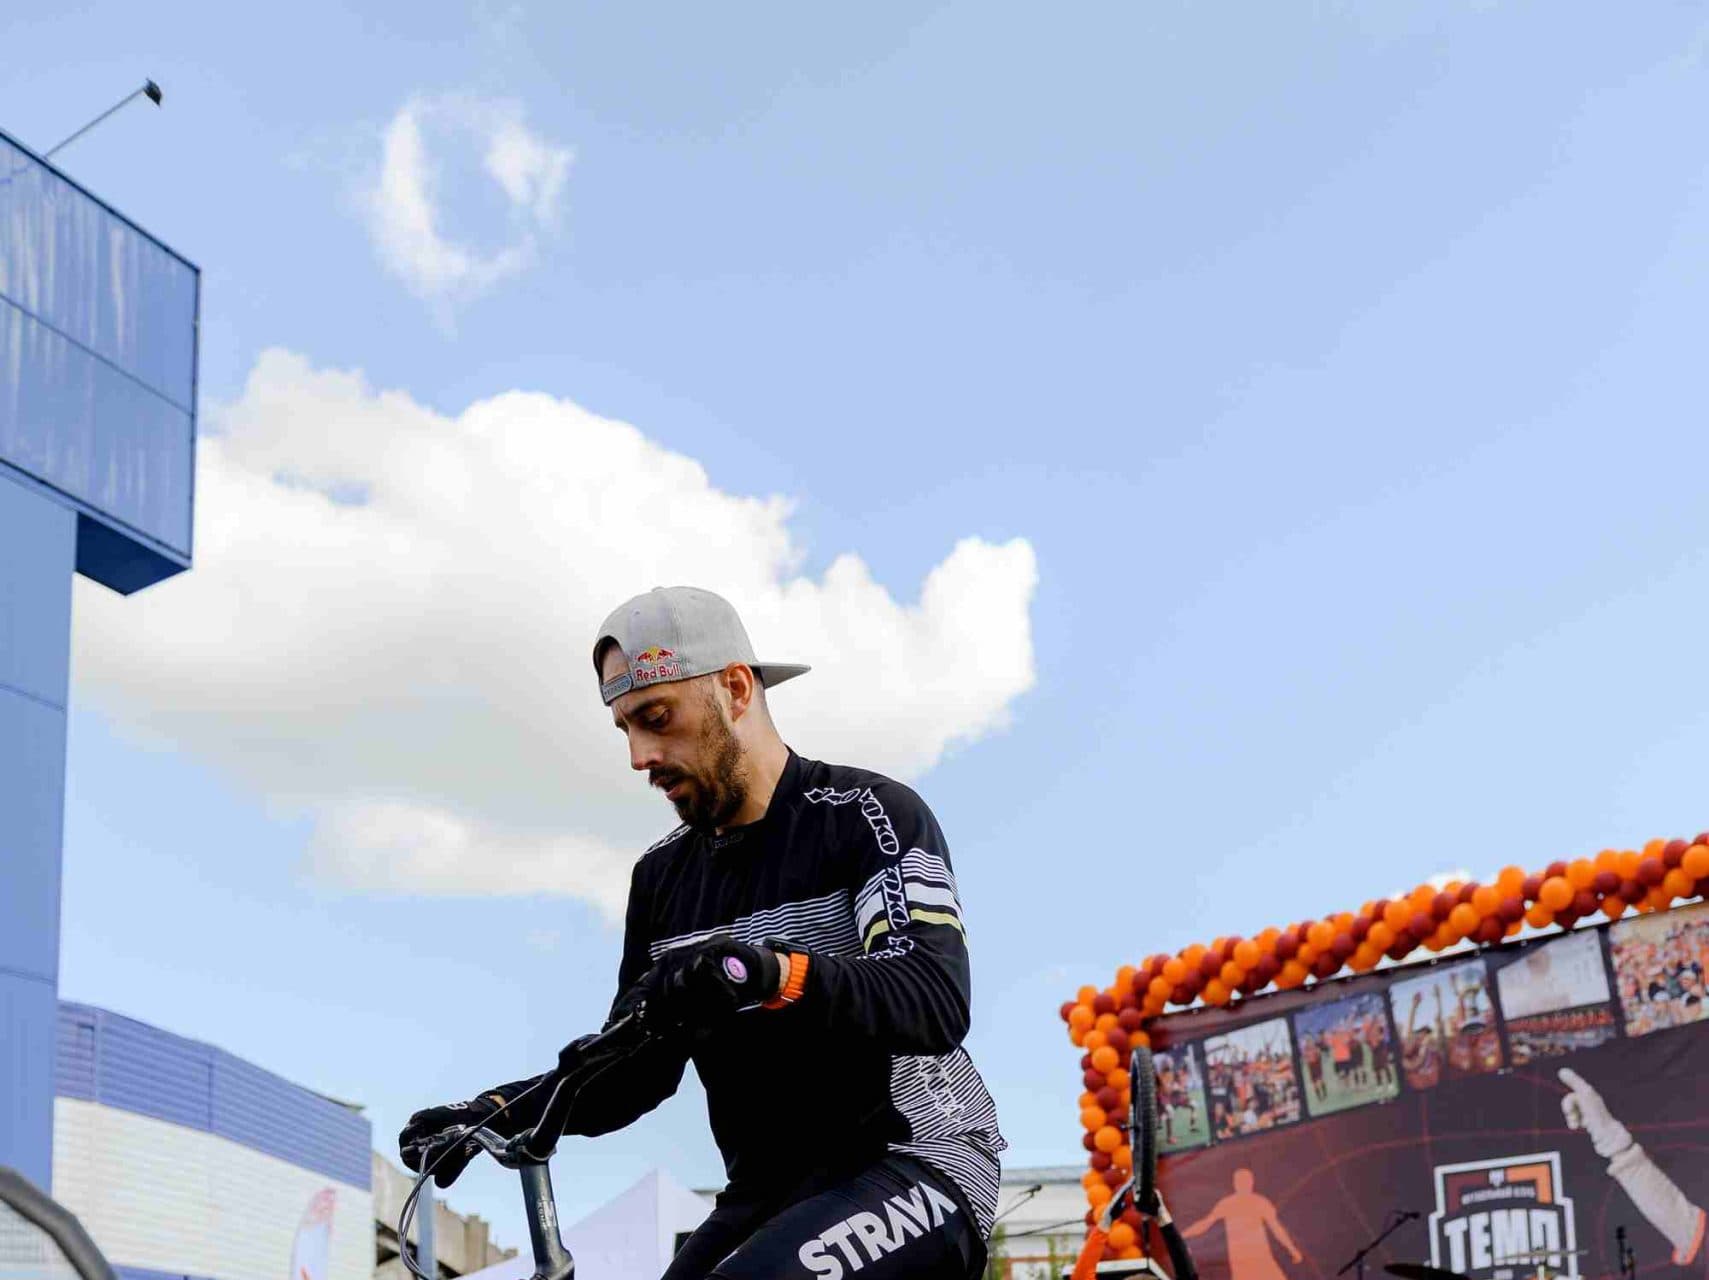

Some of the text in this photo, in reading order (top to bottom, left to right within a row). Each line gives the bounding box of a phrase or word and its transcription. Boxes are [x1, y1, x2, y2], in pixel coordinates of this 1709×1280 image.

[635, 663, 680, 681] Red Bull
[1444, 1208, 1562, 1274] ТЕМП
